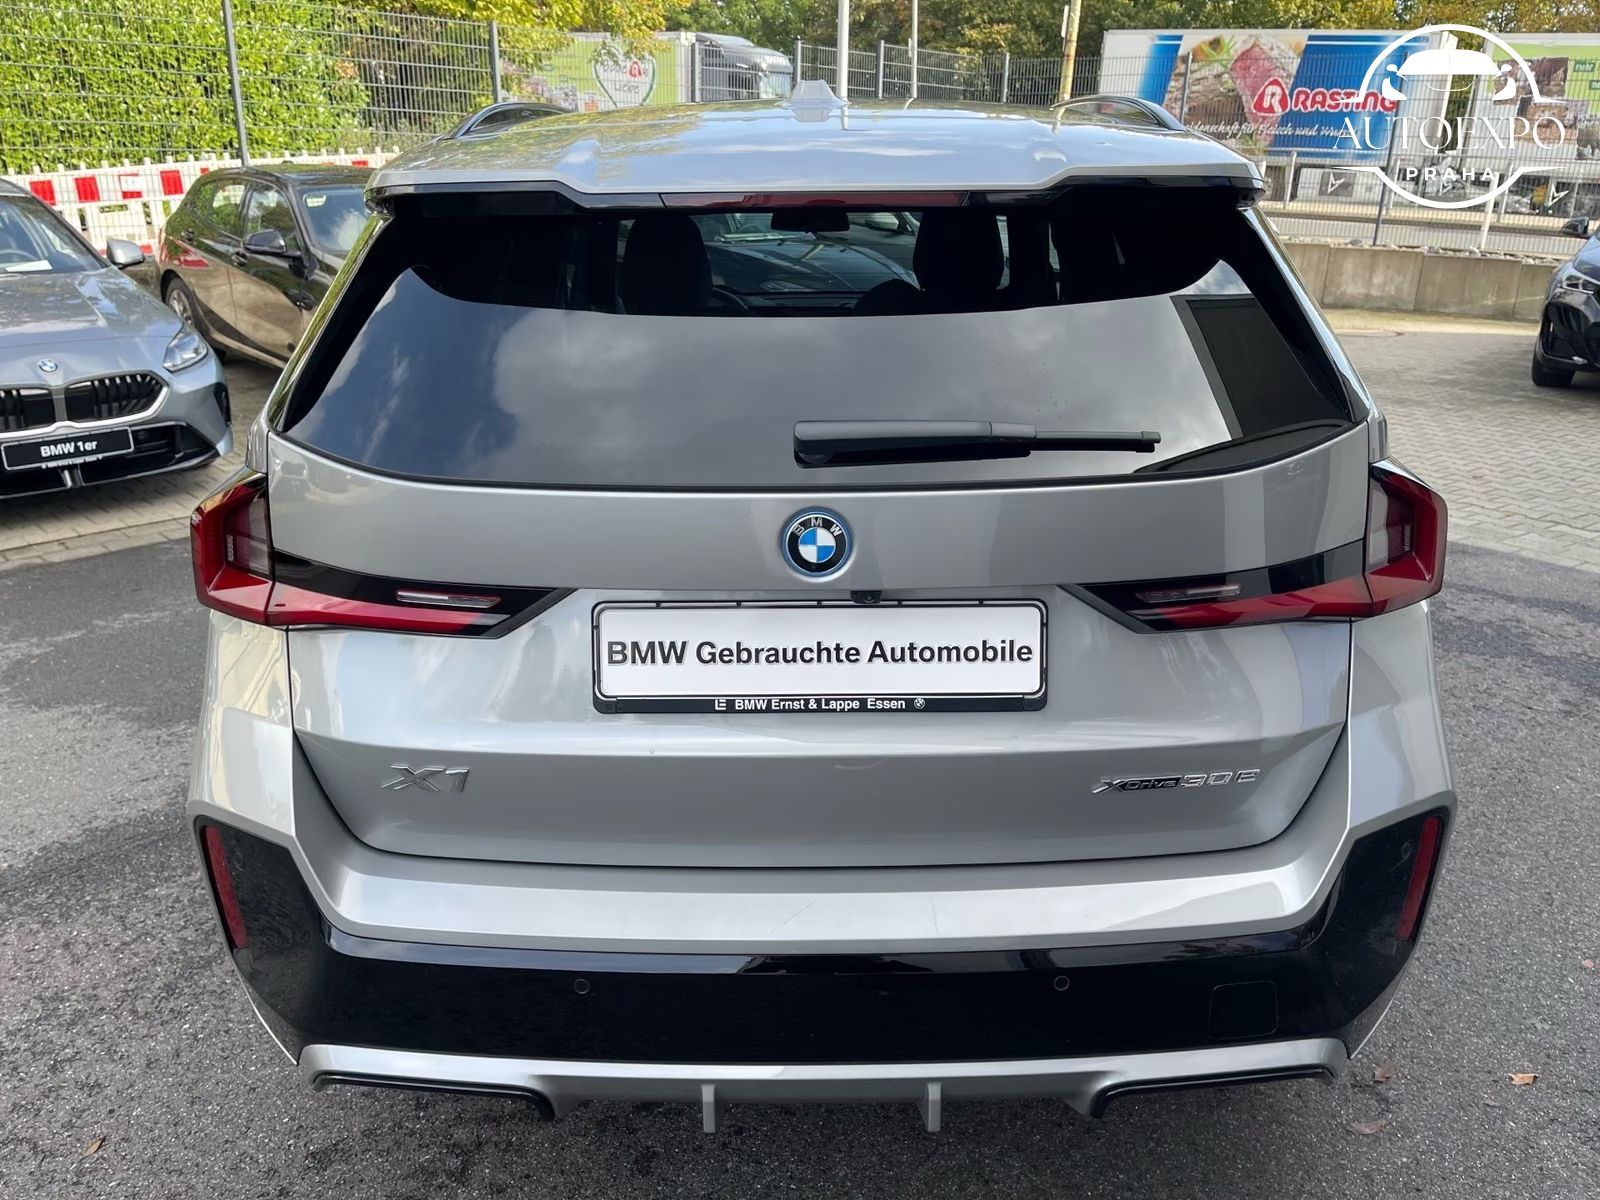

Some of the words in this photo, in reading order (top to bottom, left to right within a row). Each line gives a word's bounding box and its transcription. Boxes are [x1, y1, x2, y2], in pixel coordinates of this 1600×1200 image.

[1292, 88, 1398, 113] RASTING
[40, 441, 75, 457] BMW
[76, 440, 98, 452] 1er
[791, 516, 843, 537] BMW
[607, 641, 688, 665] BMW
[695, 639, 861, 665] Gebrauchte
[867, 639, 1034, 664] Automobile
[734, 699, 768, 711] BMW
[771, 699, 805, 711] Ernst
[808, 698, 818, 710] &
[821, 698, 860, 712] Lappe
[867, 697, 906, 709] Essen
[380, 763, 470, 792] X1
